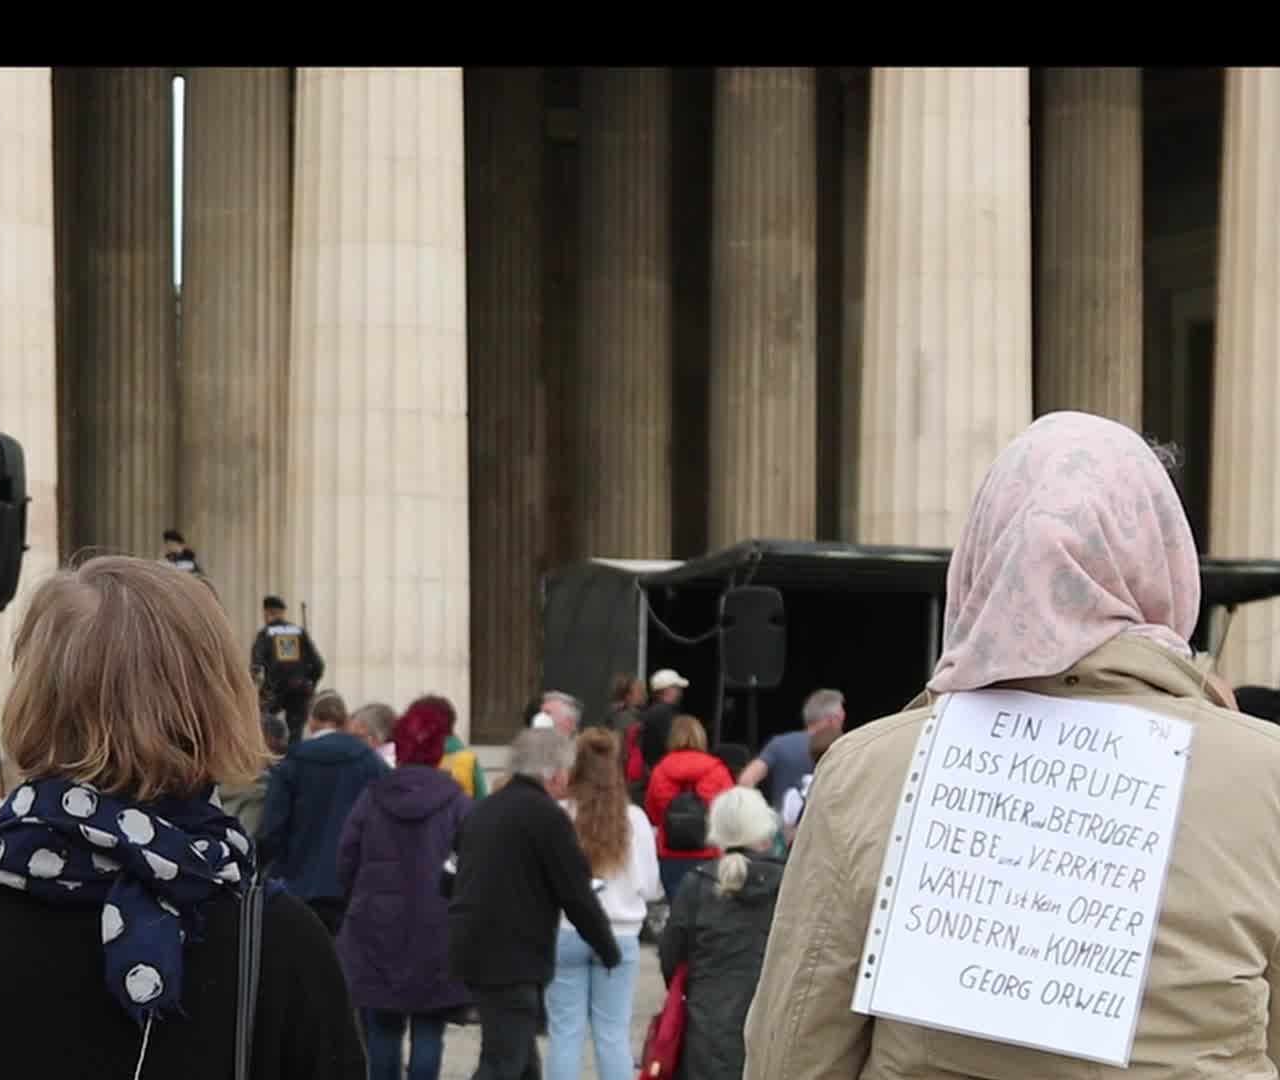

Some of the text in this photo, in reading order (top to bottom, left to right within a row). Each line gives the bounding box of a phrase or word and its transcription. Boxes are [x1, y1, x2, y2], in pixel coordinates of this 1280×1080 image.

[990, 711, 1123, 760] EIN VOLK
[942, 745, 1167, 810] DASS KORRUPTE
[925, 820, 1001, 859] DIEBE
[1028, 844, 1146, 893] VERRÄTER
[919, 862, 1003, 905] WÄHLT
[1067, 895, 1144, 936] OPFER
[905, 904, 1021, 952] SONDERN
[1044, 931, 1142, 978] KOMPLIZE
[959, 964, 1126, 1019] GEORG ORWELL
